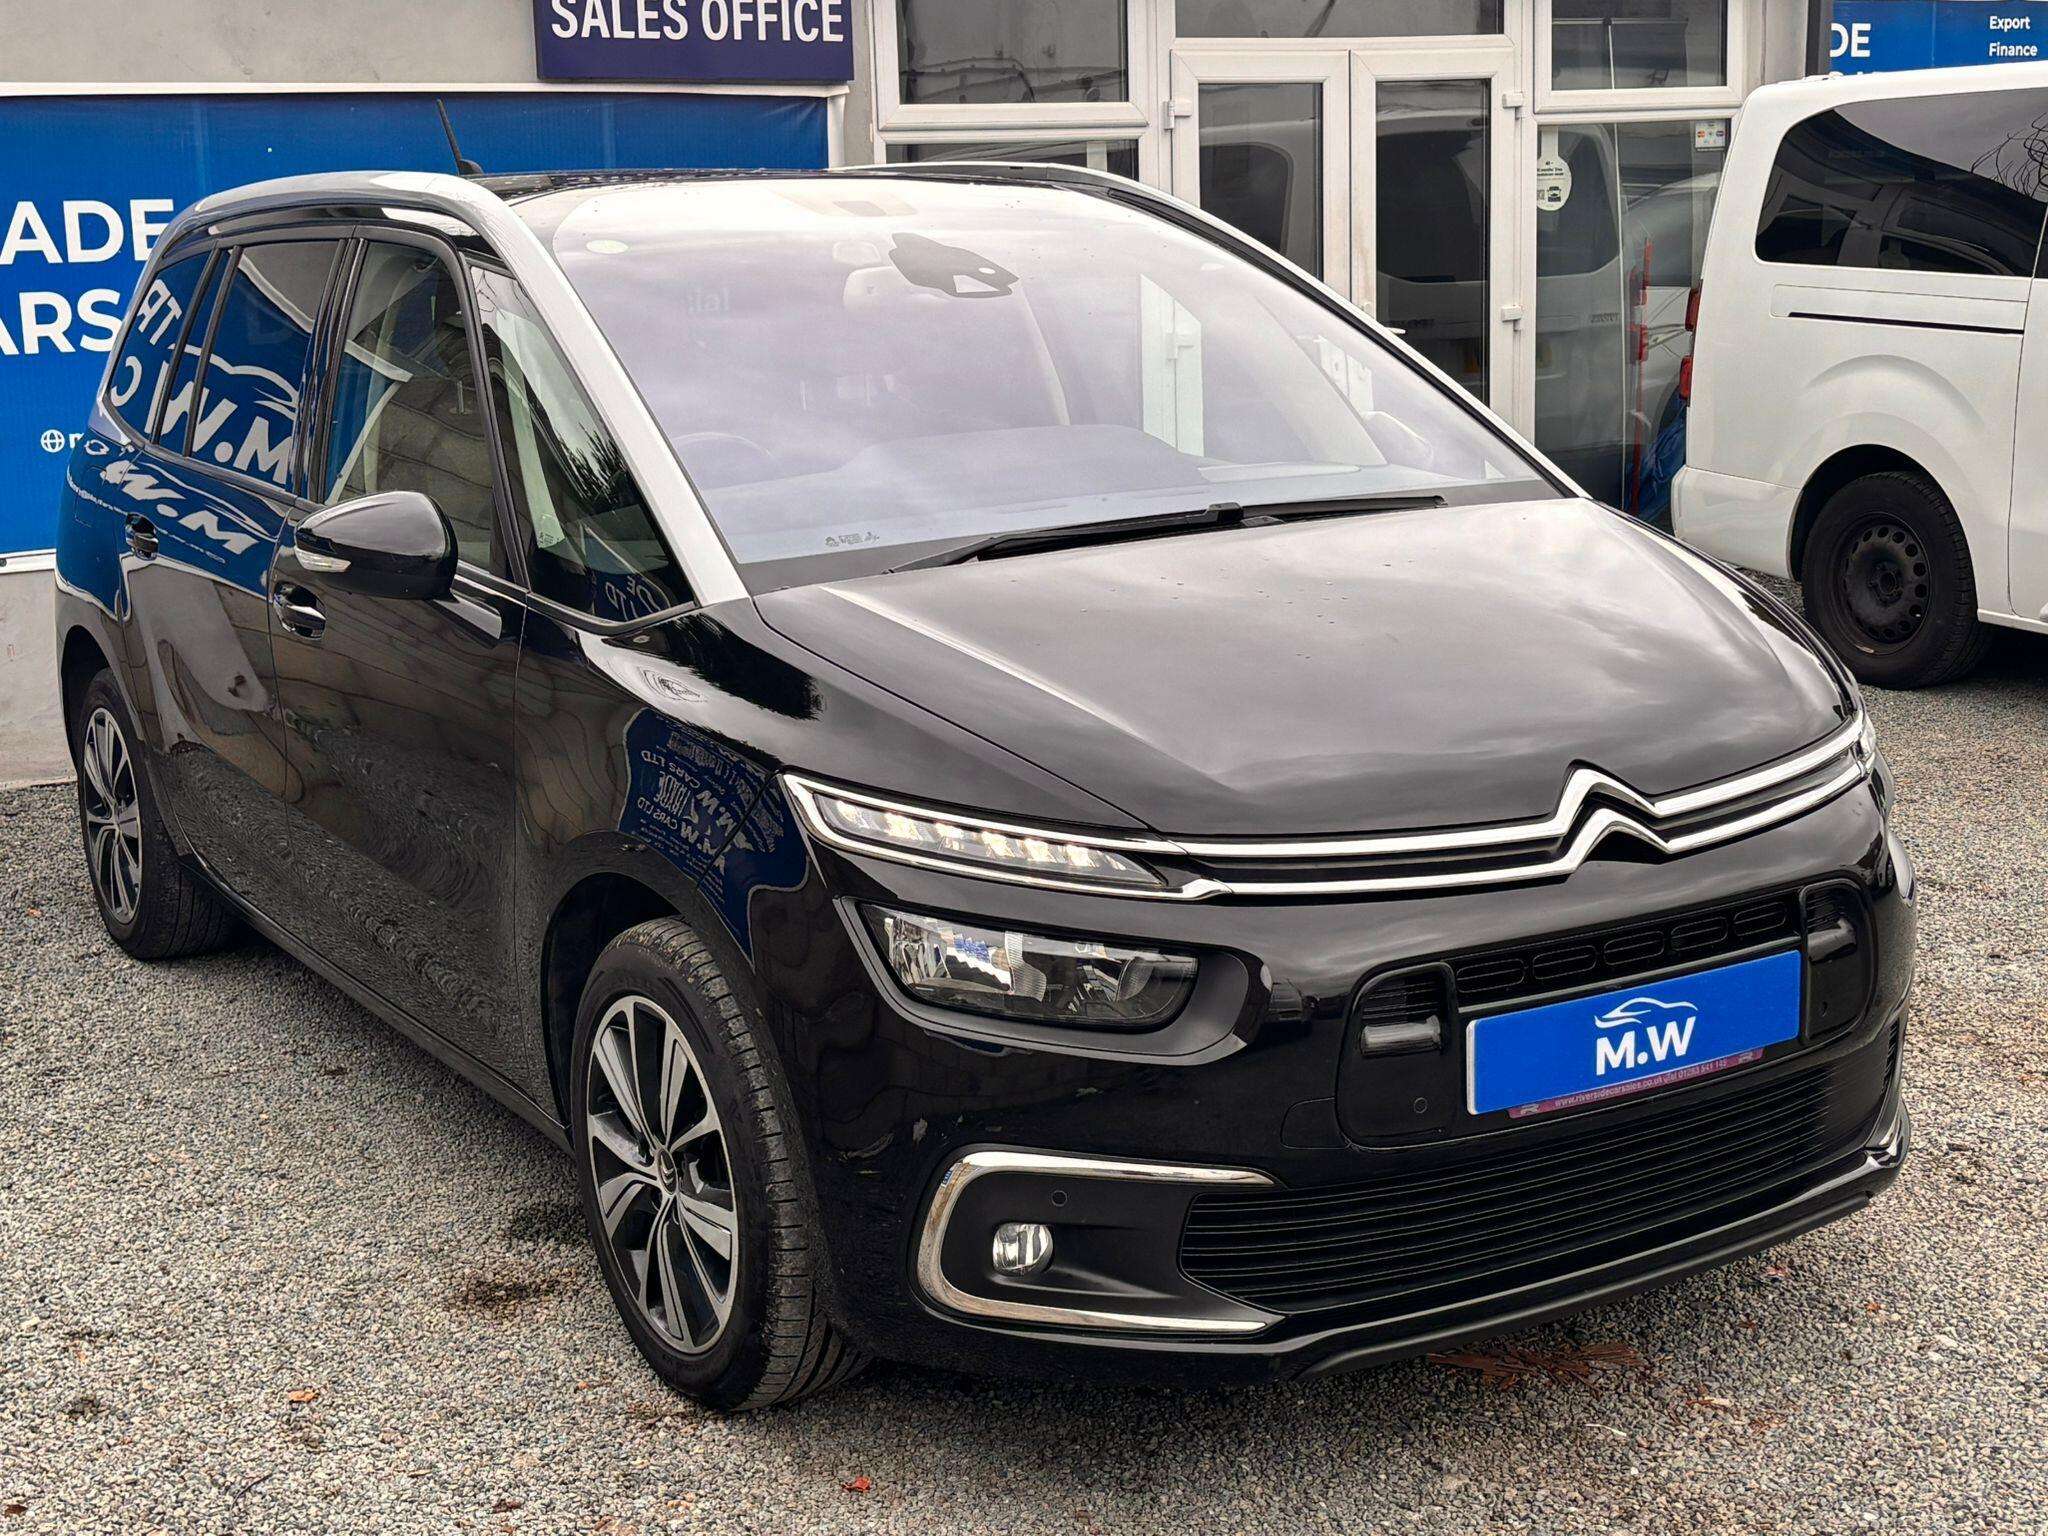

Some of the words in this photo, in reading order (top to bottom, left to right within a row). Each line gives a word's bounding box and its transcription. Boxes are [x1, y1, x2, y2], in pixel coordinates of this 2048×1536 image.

[551, 0, 689, 40] SALES
[701, 0, 844, 42] OFFICE
[1989, 16, 2031, 32] Export
[1988, 42, 2038, 57] Finance
[1595, 1015, 1697, 1076] M.W
